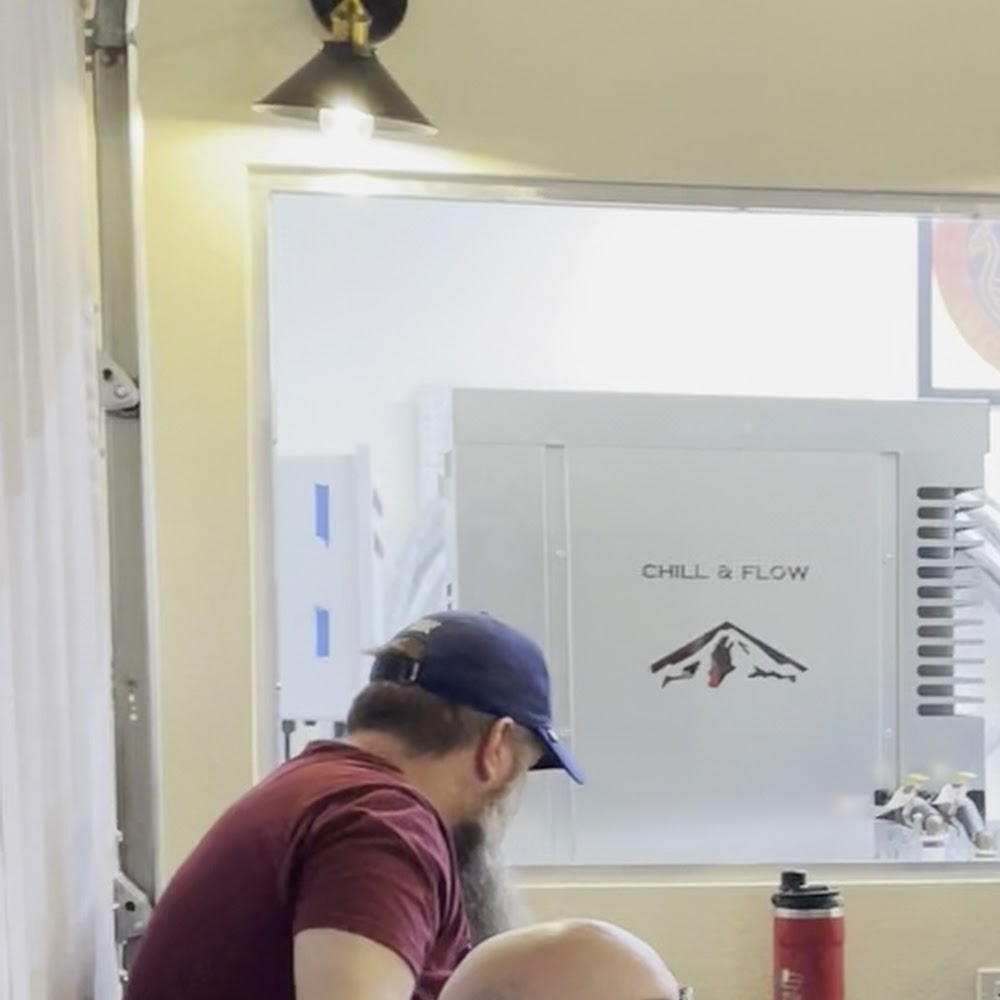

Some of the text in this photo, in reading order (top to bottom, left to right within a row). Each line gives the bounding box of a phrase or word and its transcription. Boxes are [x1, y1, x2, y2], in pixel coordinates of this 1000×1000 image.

[642, 563, 809, 581] CHILL & FLOW
